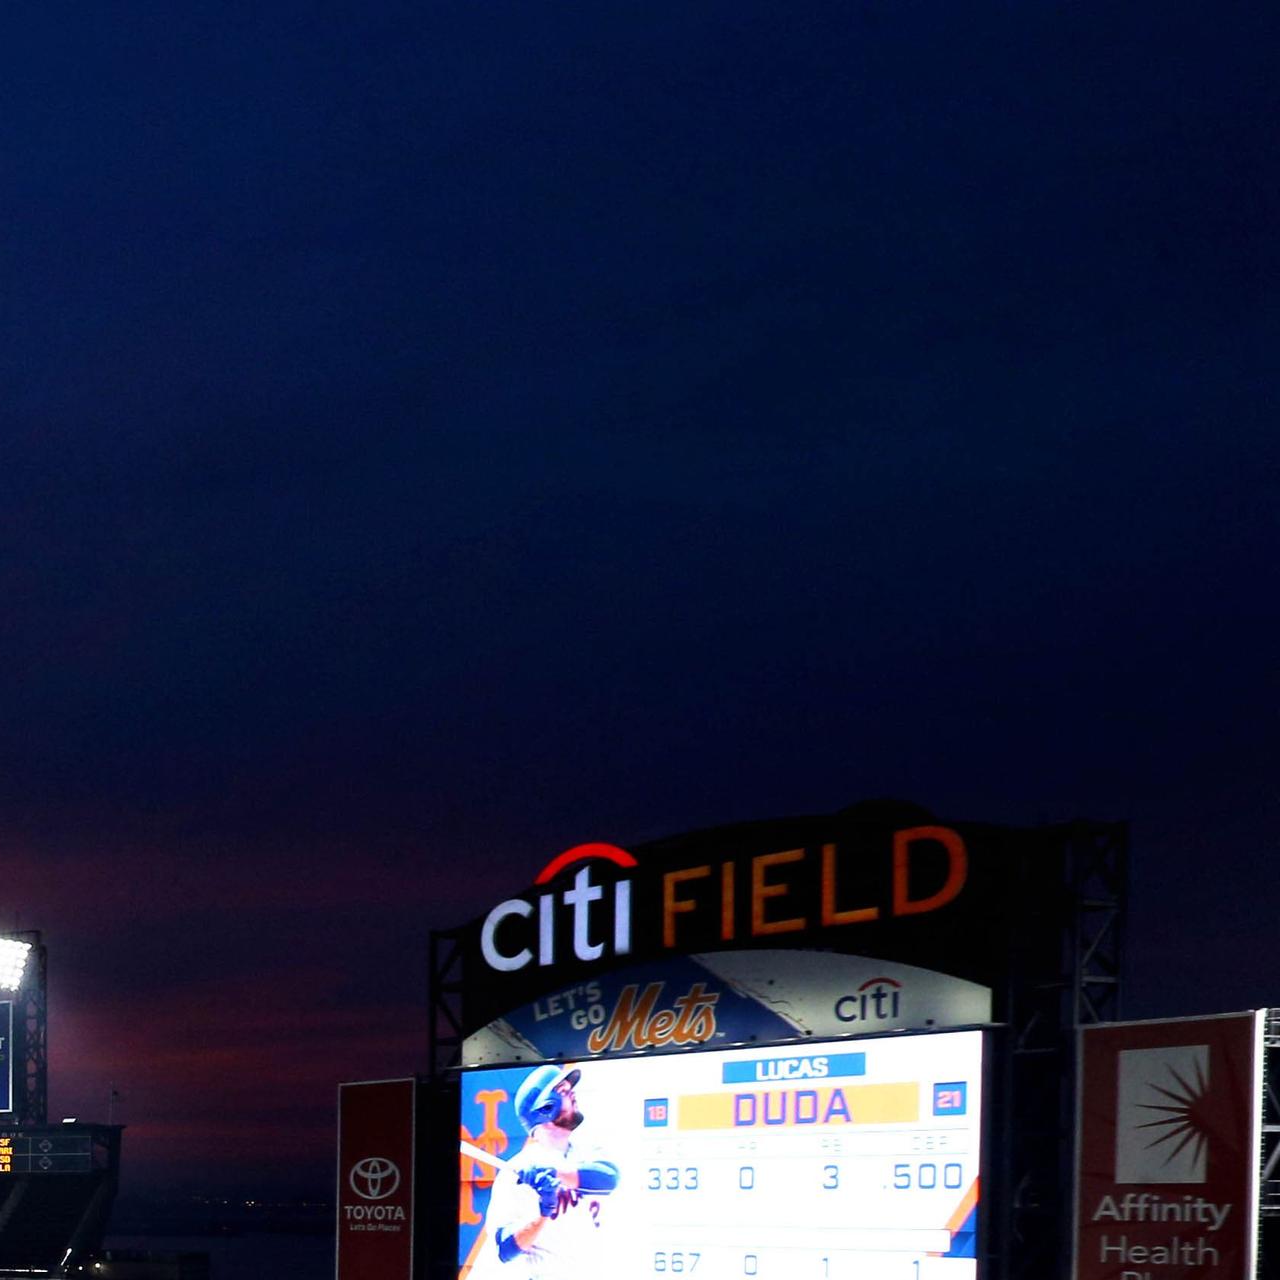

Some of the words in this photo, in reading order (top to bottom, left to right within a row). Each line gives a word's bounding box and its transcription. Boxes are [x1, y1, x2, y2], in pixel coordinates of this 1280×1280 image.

[481, 867, 631, 972] citi
[664, 826, 968, 948] FIELD
[533, 982, 603, 1022] LET'S
[835, 985, 900, 1022] citi
[571, 1008, 605, 1031] GO
[586, 983, 720, 1054] Mets
[756, 1057, 829, 1081] LUCAS
[734, 1086, 853, 1127] DUDA
[937, 1090, 961, 1109] 21
[0, 1138, 11, 1146] SF
[0, 1164, 11, 1172] LA
[740, 1166, 754, 1190] 0
[823, 1165, 839, 1189] 3
[344, 1205, 407, 1221] TOYOTA
[1093, 1194, 1232, 1230] Affinity
[1100, 1235, 1219, 1267] Health
